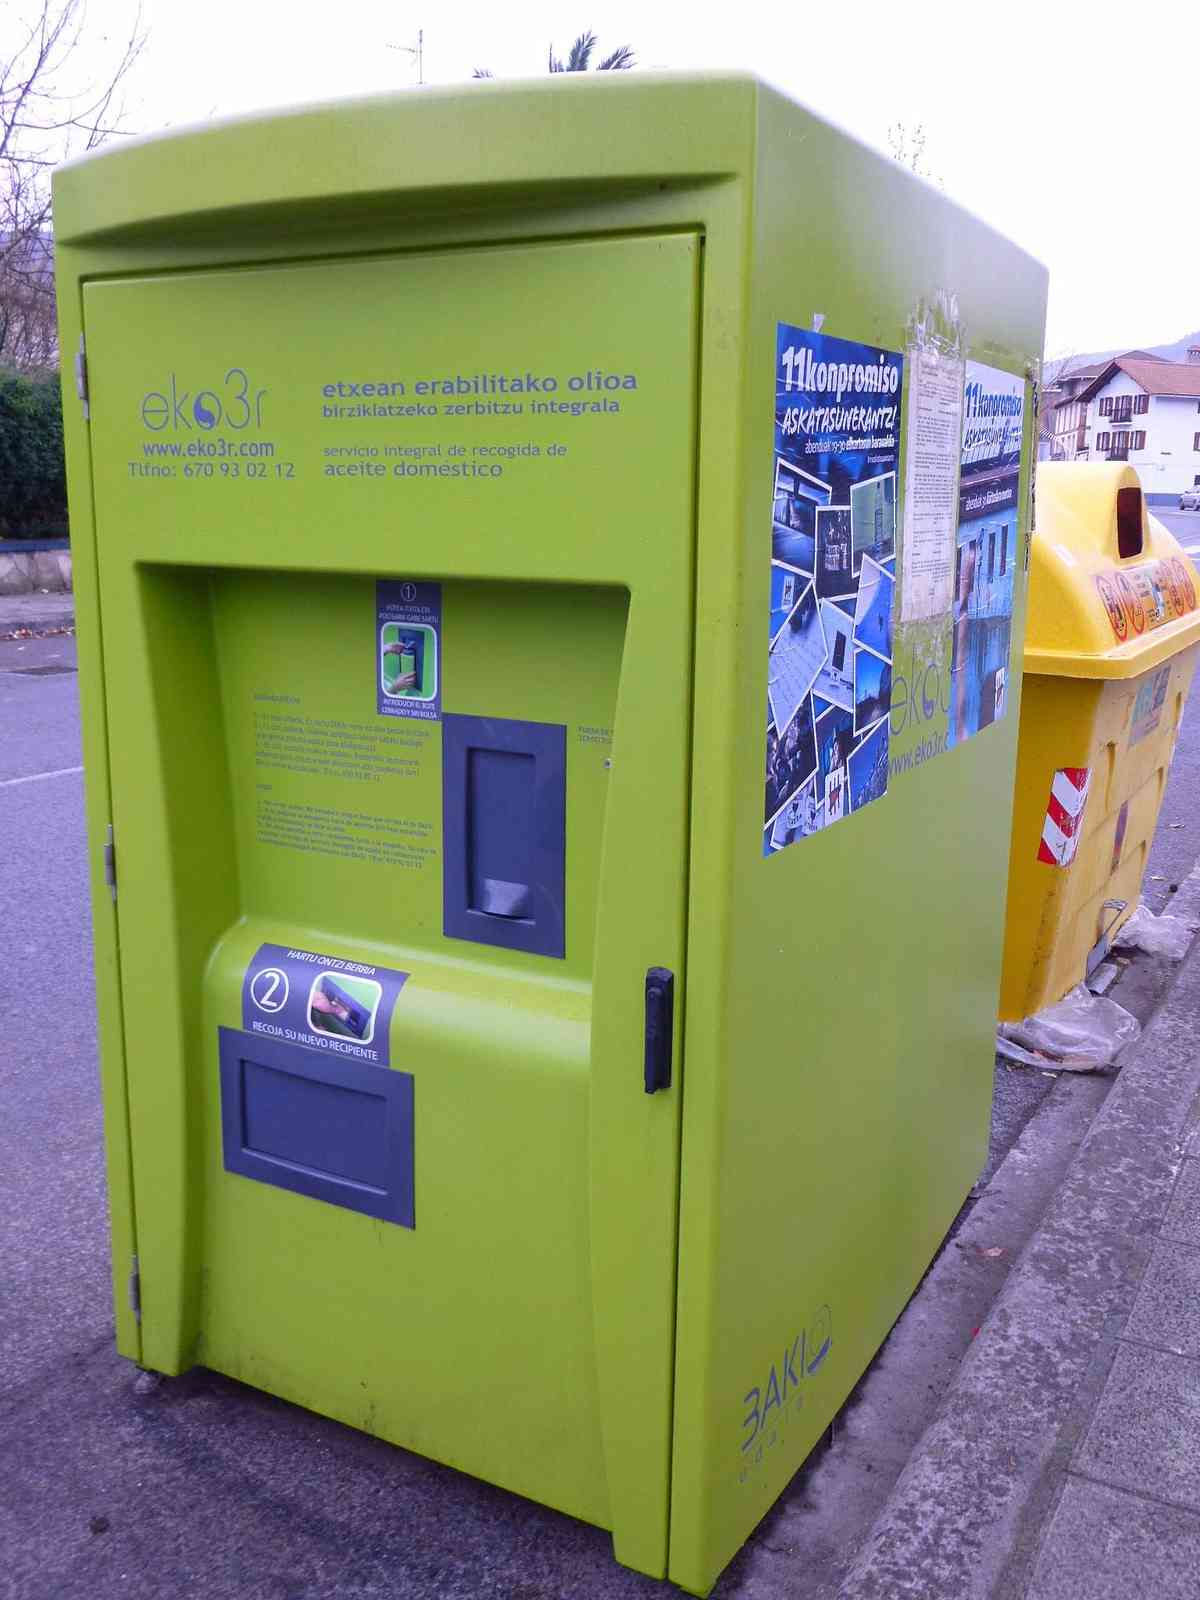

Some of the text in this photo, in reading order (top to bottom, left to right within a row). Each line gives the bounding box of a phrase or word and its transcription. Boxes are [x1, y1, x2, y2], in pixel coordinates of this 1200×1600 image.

[322, 371, 637, 398] etxean erabilitako olioa
[142, 368, 268, 431] eko3r
[322, 398, 620, 417] birziklatzeko zerbitzu integrala
[143, 438, 274, 457] www.eko3r.com
[323, 442, 568, 459] servicio integral de recogida de
[183, 462, 214, 477] 670
[219, 462, 241, 477] 93
[246, 462, 268, 477] 02
[275, 462, 296, 478] 12
[324, 460, 386, 477] aceite
[287, 950, 376, 975] HARTU ONTZI BERRIA
[259, 971, 281, 1008] 2
[252, 1020, 379, 1061] RECOJA SU NUEVO RECIPIENTE
